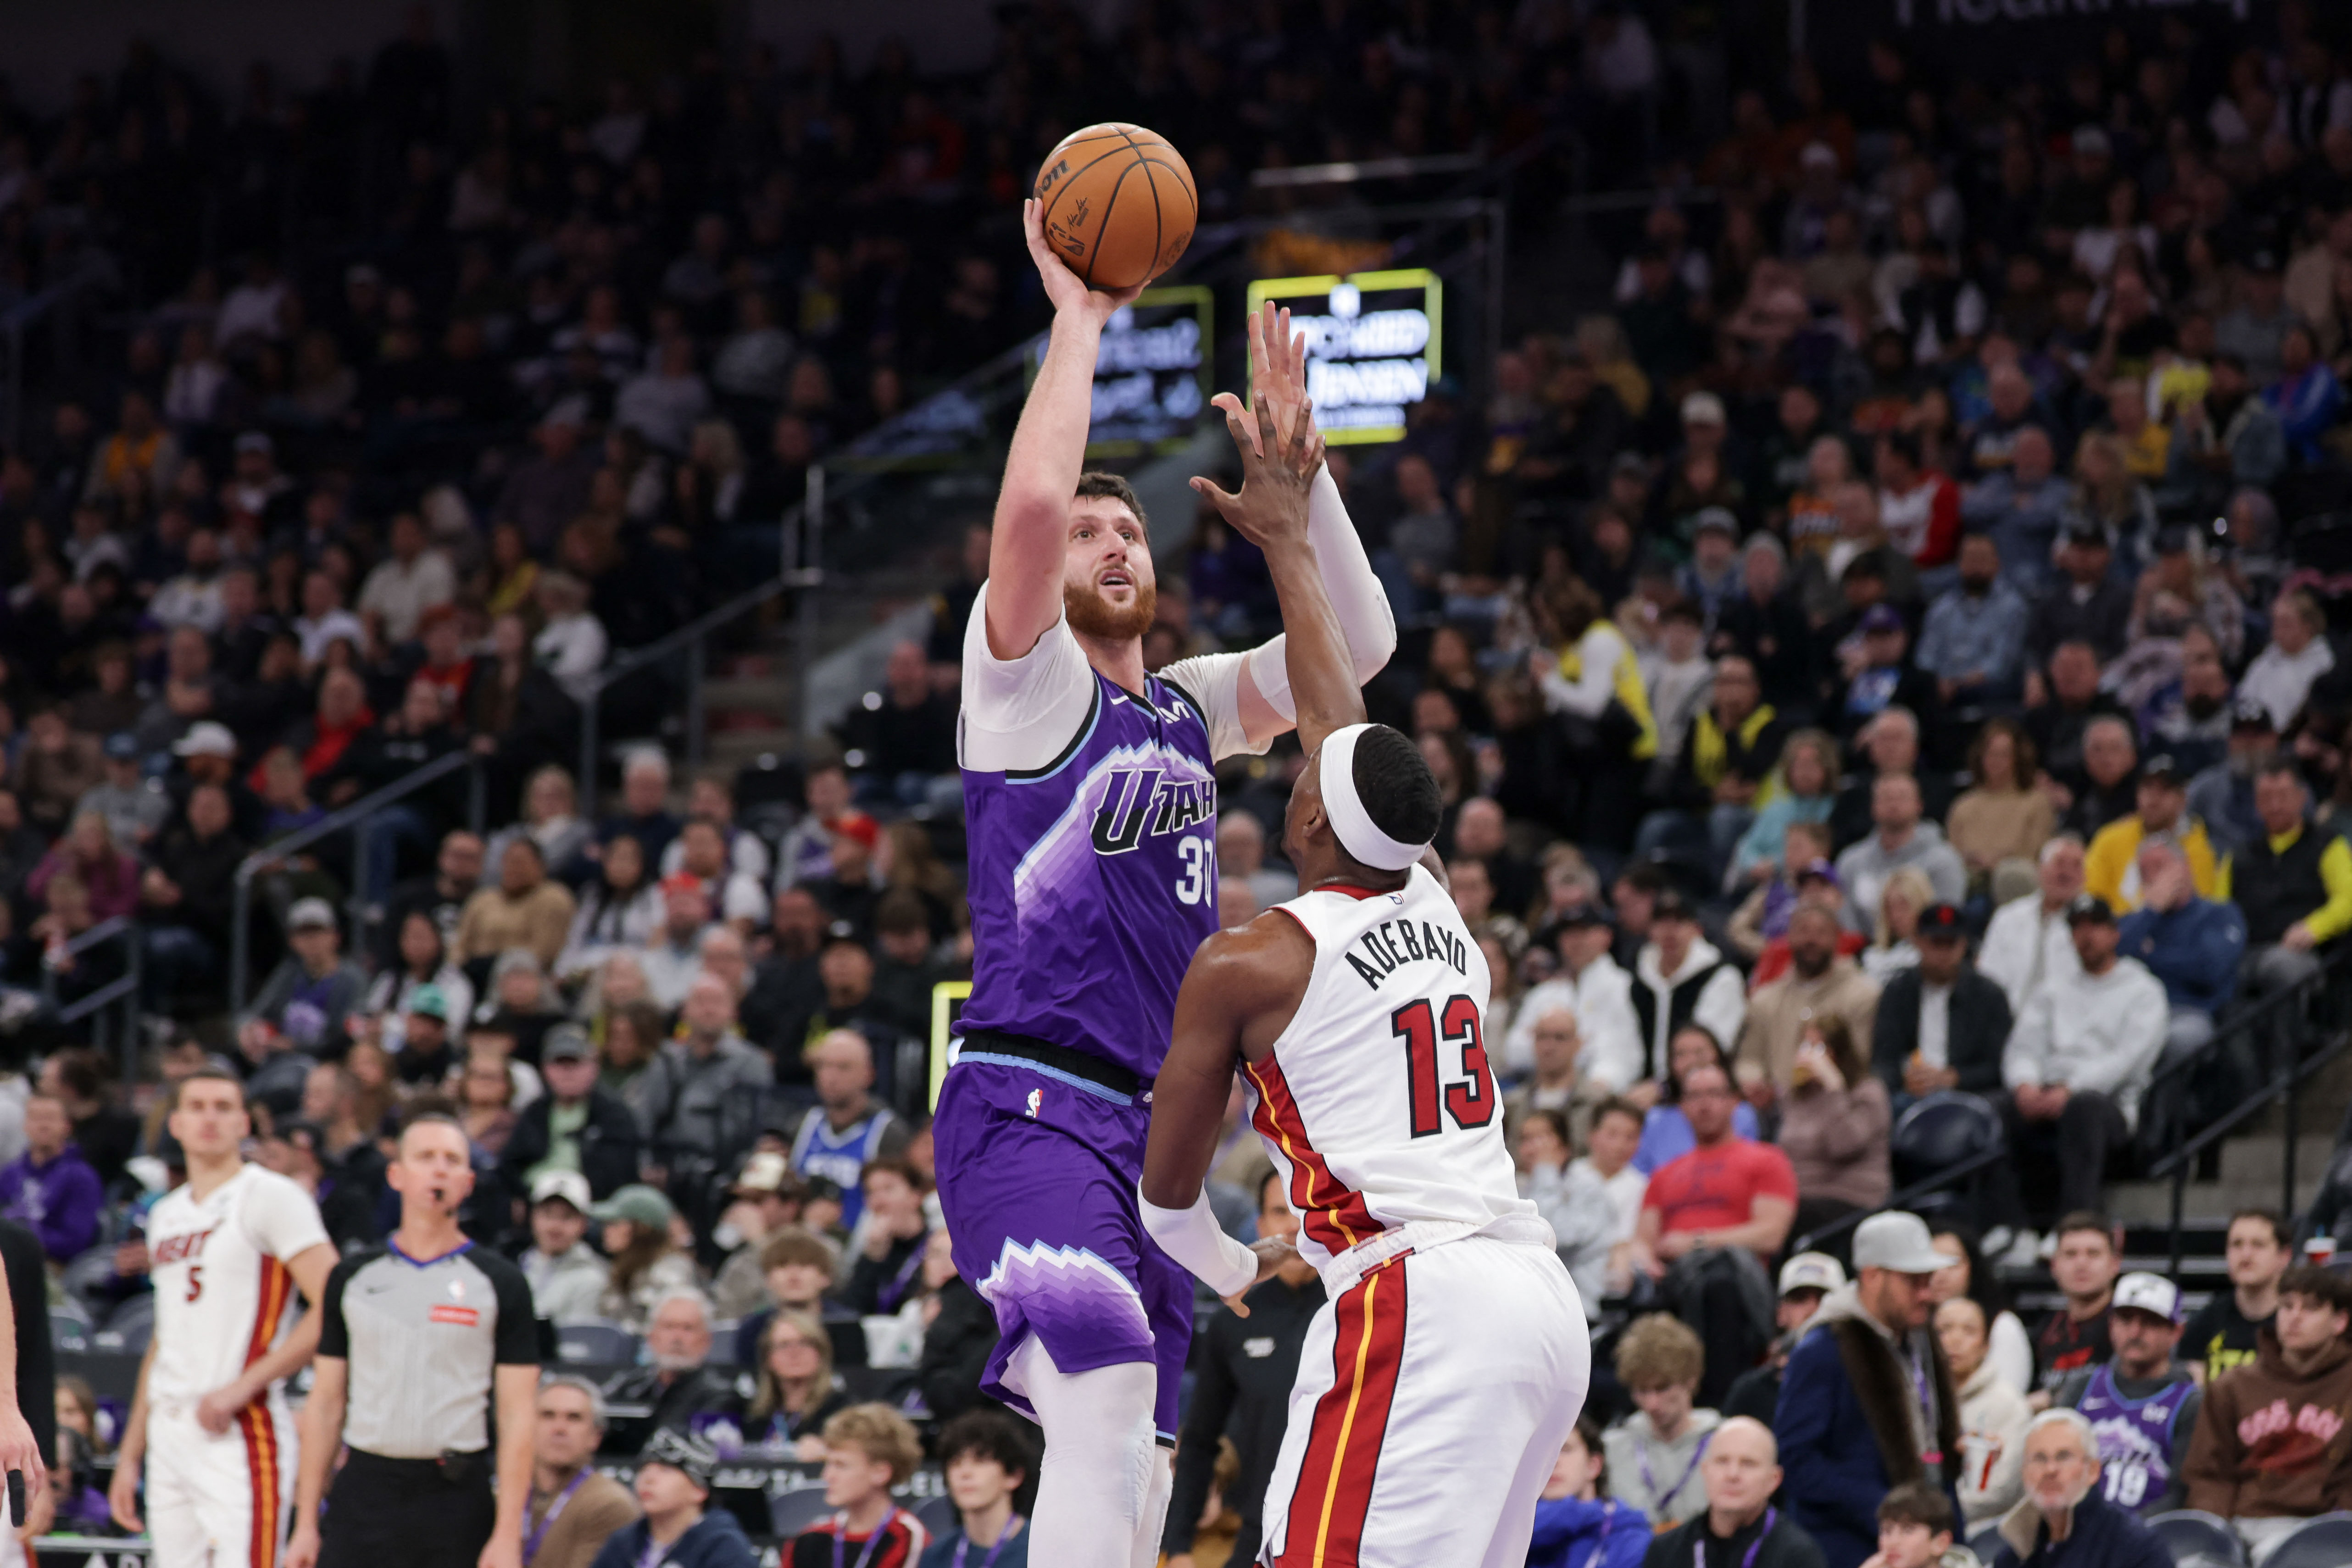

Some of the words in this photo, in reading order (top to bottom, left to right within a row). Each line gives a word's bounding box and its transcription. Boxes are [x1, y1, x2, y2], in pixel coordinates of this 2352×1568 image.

[1090, 768, 1217, 856] UTAH
[1345, 919, 1466, 991] ADEBAYO
[1391, 994, 1495, 1140] 13
[186, 1265, 203, 1302] 5
